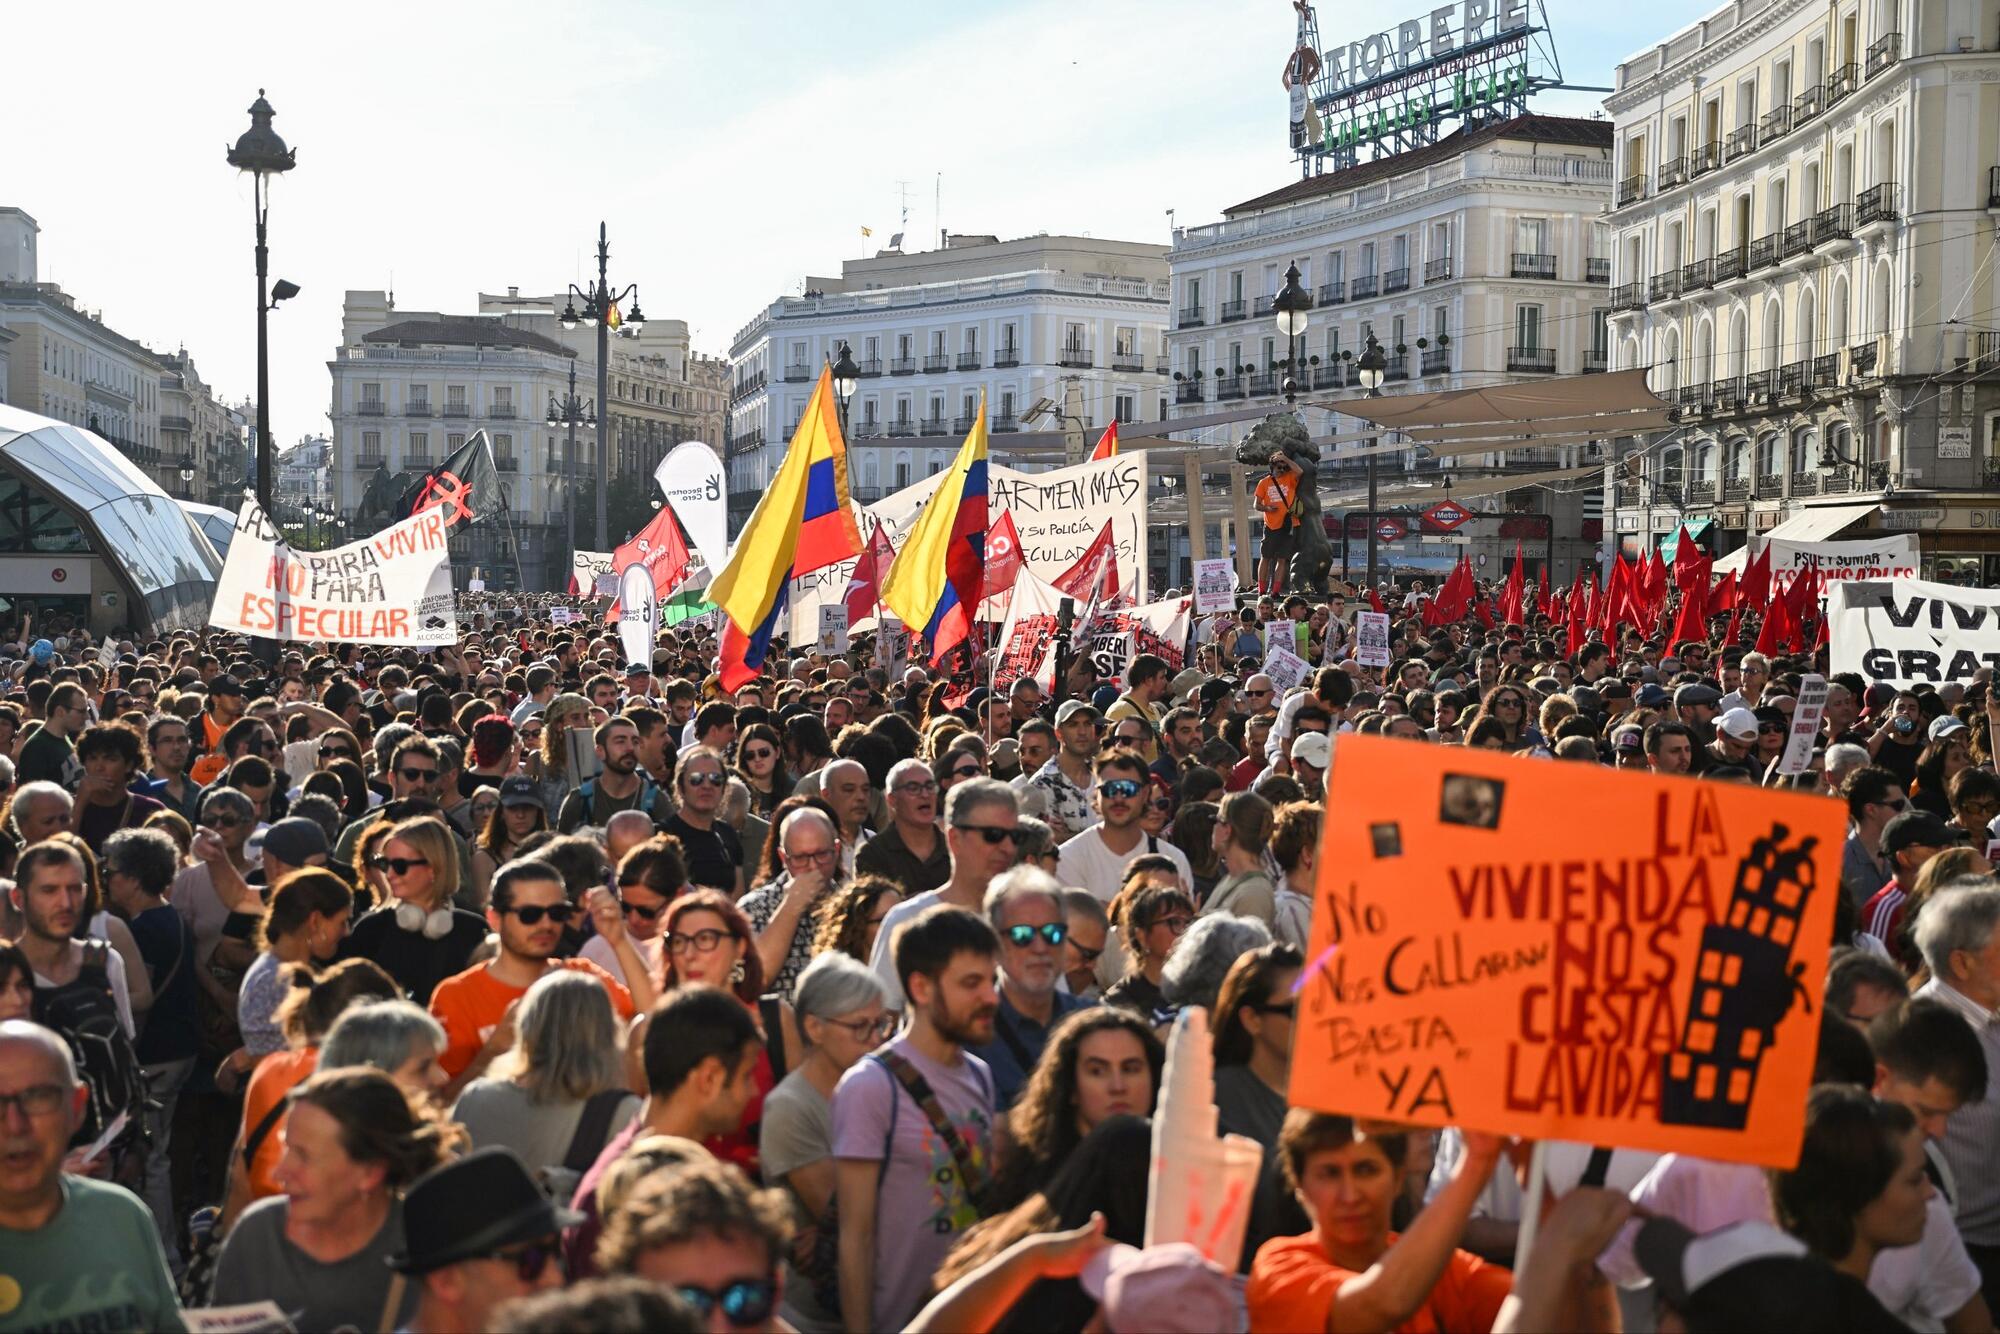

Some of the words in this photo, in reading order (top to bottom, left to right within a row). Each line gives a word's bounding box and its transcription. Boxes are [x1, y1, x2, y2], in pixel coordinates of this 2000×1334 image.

[1325, 34, 1384, 91] TIO
[1399, 0, 1526, 68] PEPE
[1436, 511, 1459, 519] Metro
[1440, 536, 1453, 544] Sol
[266, 555, 306, 597] NO
[311, 571, 386, 603] PARA
[310, 545, 379, 578] PARA
[240, 592, 409, 638] ESPECULAR
[1656, 789, 1727, 857] LA
[1448, 857, 1718, 926] VIVIENDA
[1555, 921, 1681, 990] NOS
[1520, 984, 1679, 1052] CUESTA
